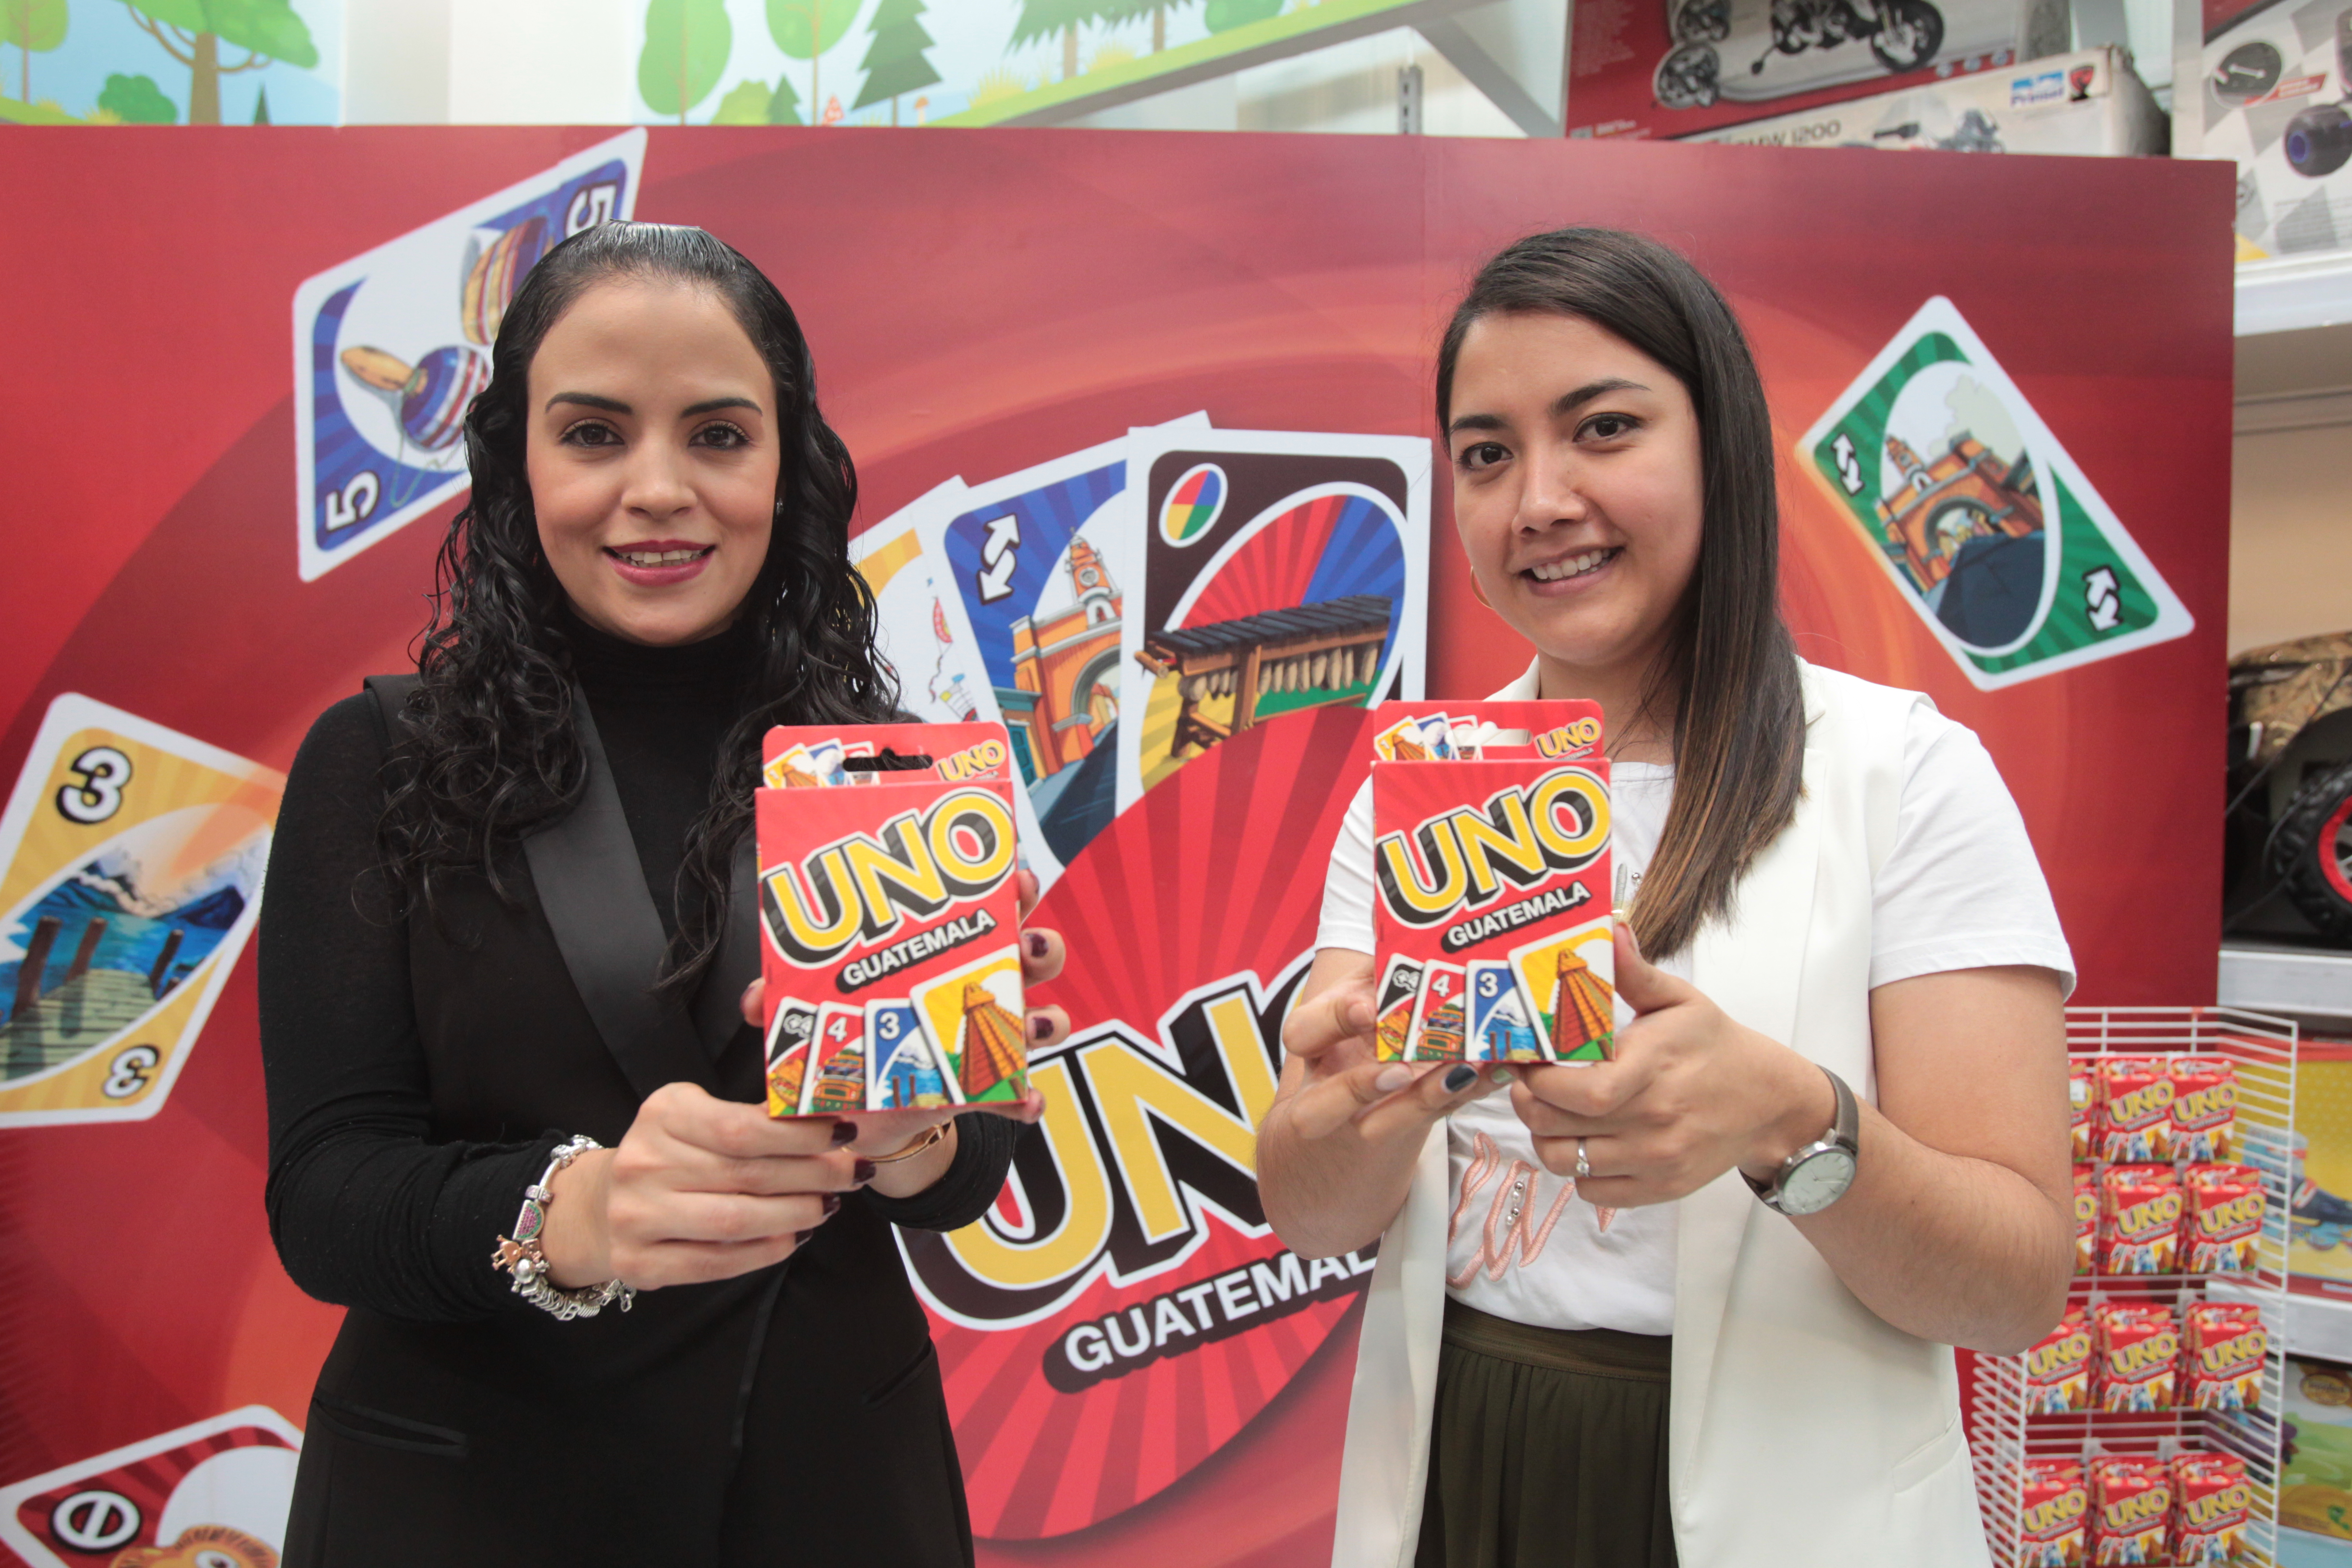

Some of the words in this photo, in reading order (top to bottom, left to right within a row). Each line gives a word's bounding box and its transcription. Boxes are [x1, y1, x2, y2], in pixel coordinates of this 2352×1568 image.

[325, 471, 380, 532] 5
[935, 739, 1006, 782] UNO
[1534, 717, 1602, 760] UNO
[56, 746, 133, 825] 3
[1376, 768, 1612, 930] UNO
[760, 786, 1017, 969] UNO
[1443, 881, 1592, 952] GUATEMALA
[837, 908, 997, 992] GUATEMALA
[1432, 974, 1450, 998] 4
[1478, 971, 1498, 998] 3
[827, 1017, 847, 1042] 4
[879, 1011, 900, 1040] 3
[2109, 1081, 2175, 1127] UNO
[2172, 1082, 2240, 1127] UNO
[903, 954, 1316, 1321] UN
[2116, 1192, 2182, 1237] UNO
[2198, 1192, 2266, 1237] UNO
[1064, 1249, 1378, 1372] GUATEMAL
[2028, 1332, 2090, 1378] UNO
[2108, 1331, 2178, 1376] UNO
[2199, 1329, 2266, 1374] UNO
[2022, 1489, 2087, 1534] UNO
[2104, 1487, 2172, 1531] UNO
[2184, 1483, 2251, 1528] UNO
